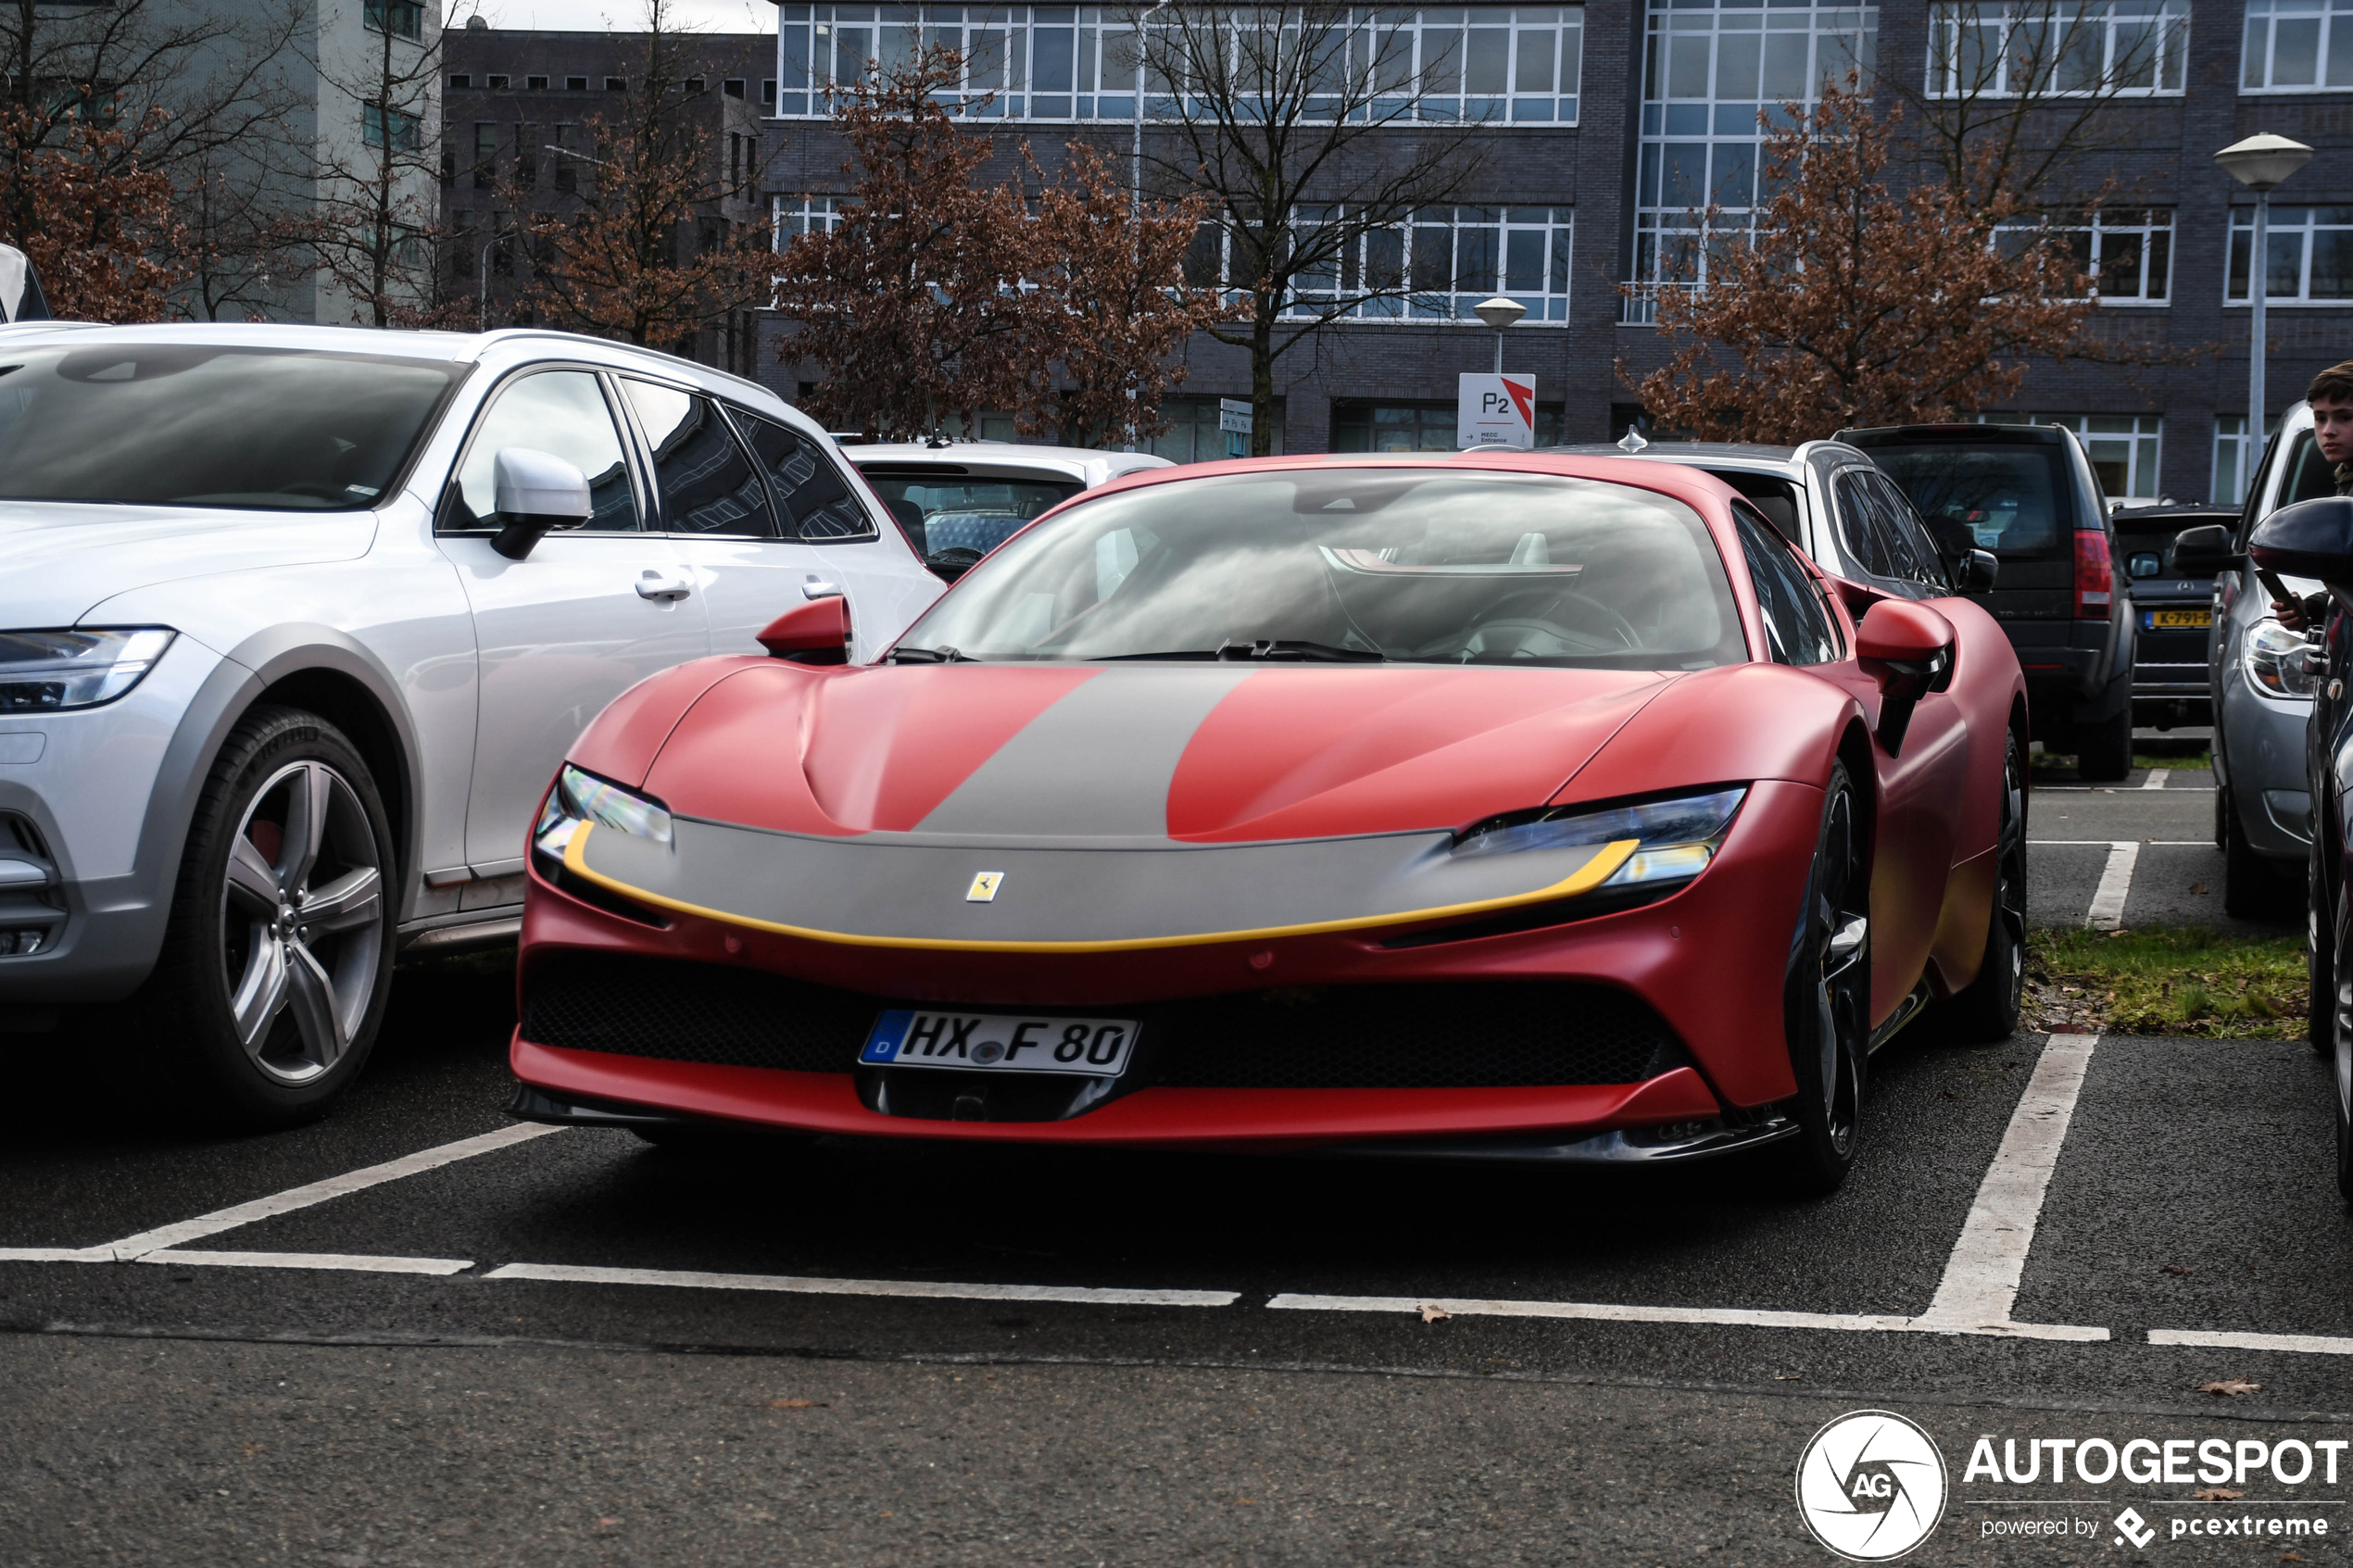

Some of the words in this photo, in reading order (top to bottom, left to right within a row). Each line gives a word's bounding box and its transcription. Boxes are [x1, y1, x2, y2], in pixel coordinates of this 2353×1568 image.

[1483, 393, 1509, 413] P2
[875, 1042, 889, 1053] D
[902, 1016, 981, 1058] HX
[1004, 1022, 1049, 1060] F
[1053, 1023, 1125, 1065] 80
